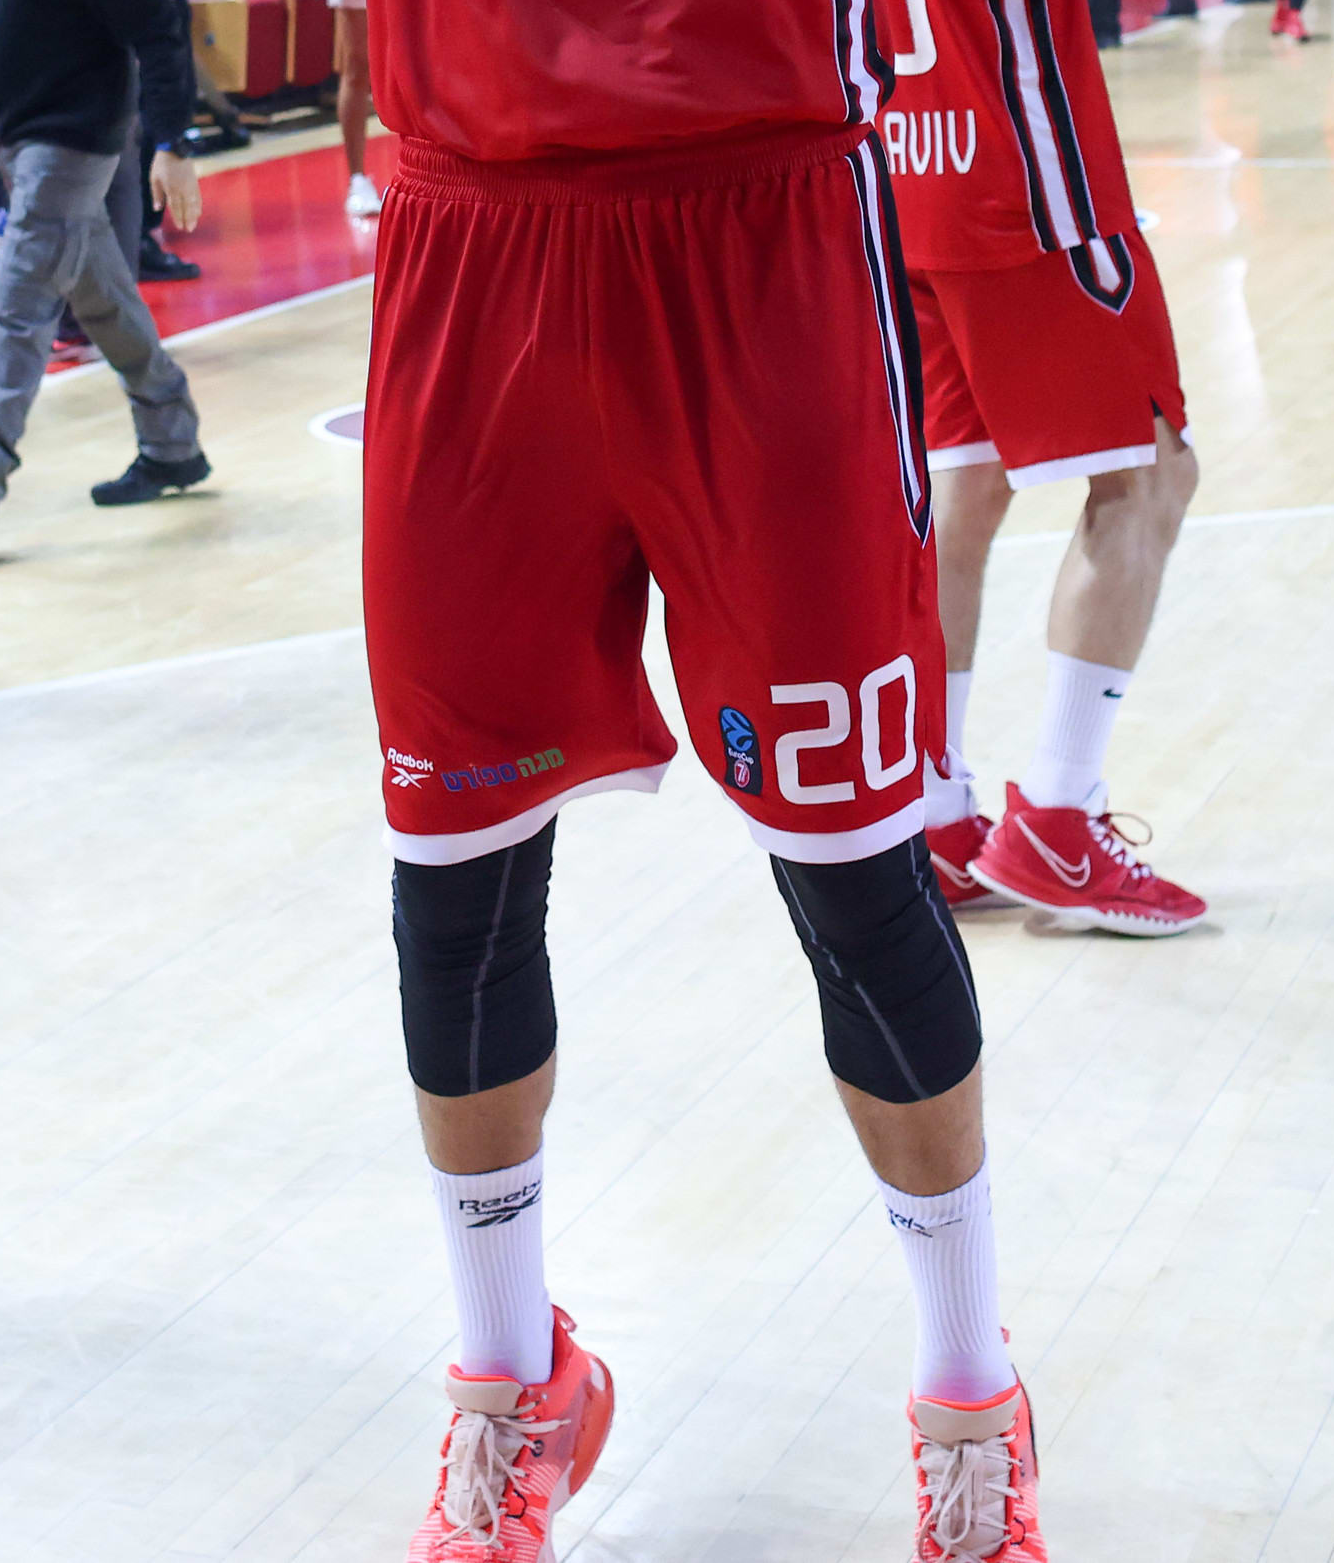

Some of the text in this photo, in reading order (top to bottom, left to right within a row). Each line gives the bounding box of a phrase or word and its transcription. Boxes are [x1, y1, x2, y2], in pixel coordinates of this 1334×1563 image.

[884, 109, 976, 175] AVIV
[387, 747, 434, 772] Reebok
[769, 653, 917, 804] 20
